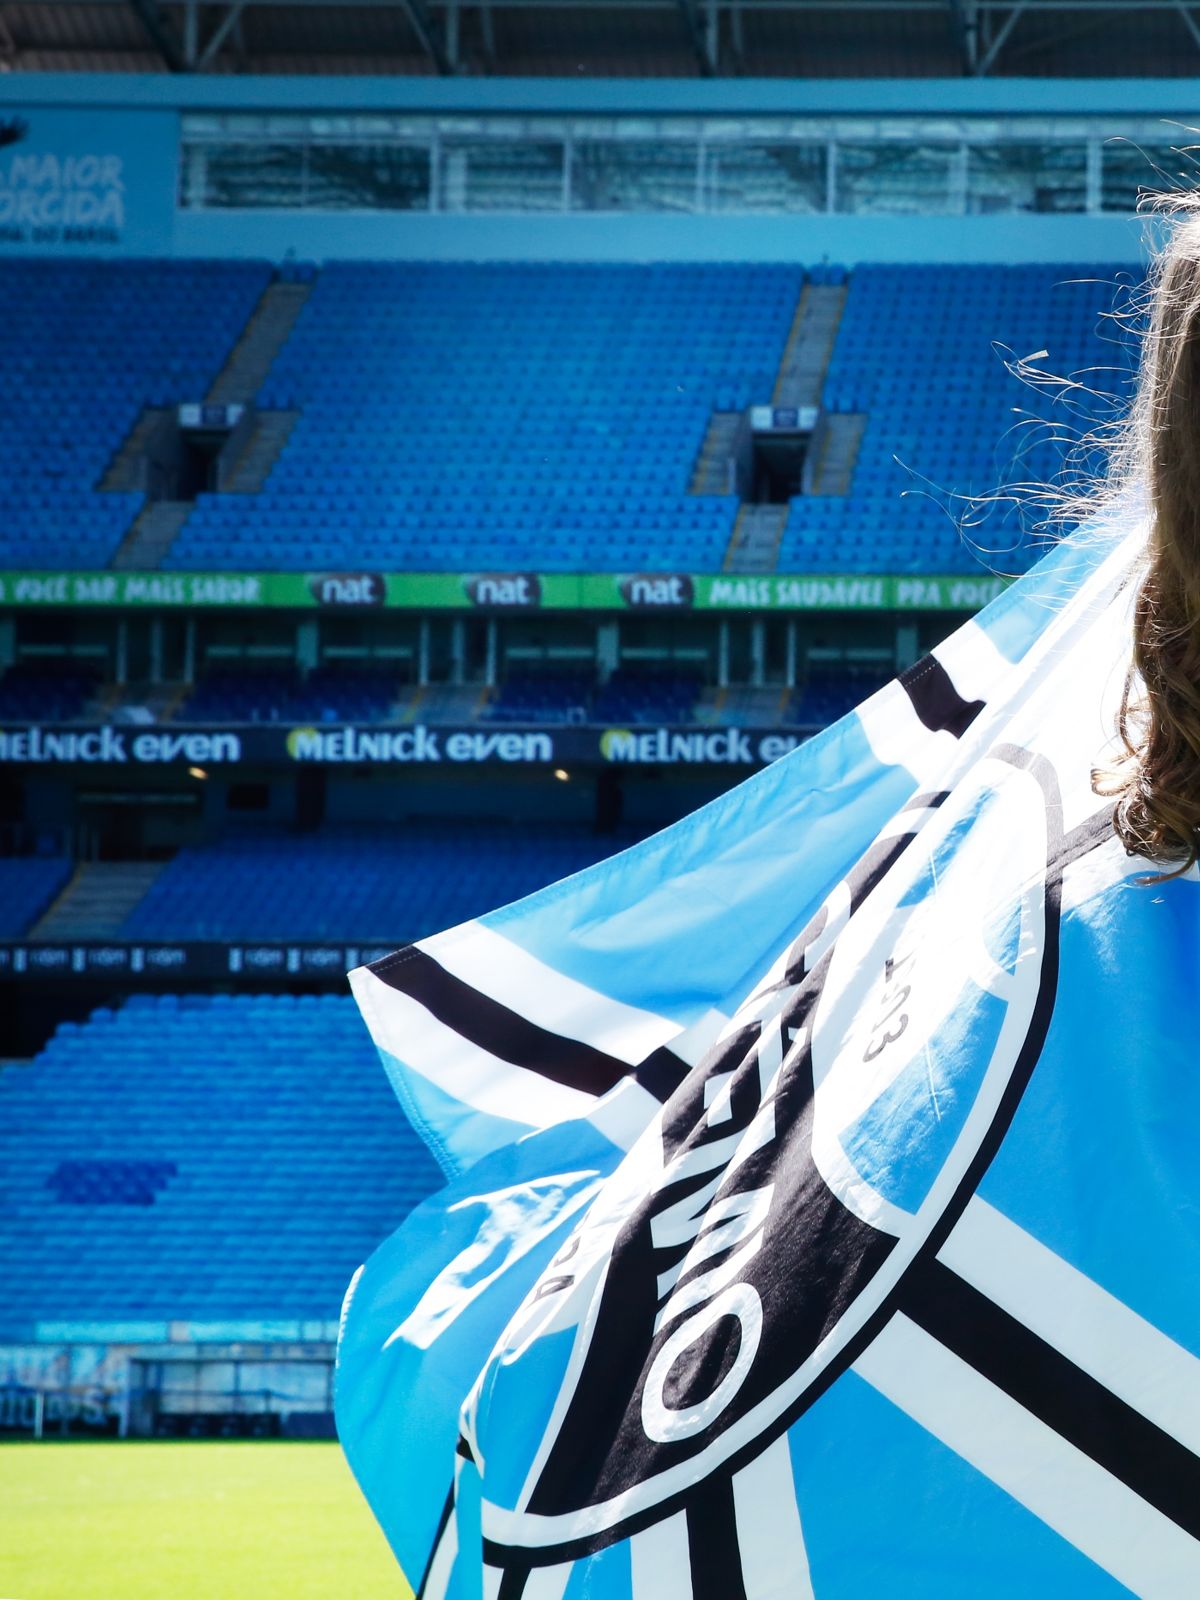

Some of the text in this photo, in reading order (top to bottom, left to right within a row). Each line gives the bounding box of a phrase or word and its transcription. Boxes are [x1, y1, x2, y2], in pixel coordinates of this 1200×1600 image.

[10, 154, 127, 192] MAIOR
[0, 190, 125, 229] ORCIDA
[322, 574, 374, 603] nat
[478, 574, 529, 604] nat
[631, 575, 683, 605] nat
[133, 732, 241, 762] even
[446, 732, 553, 762] even
